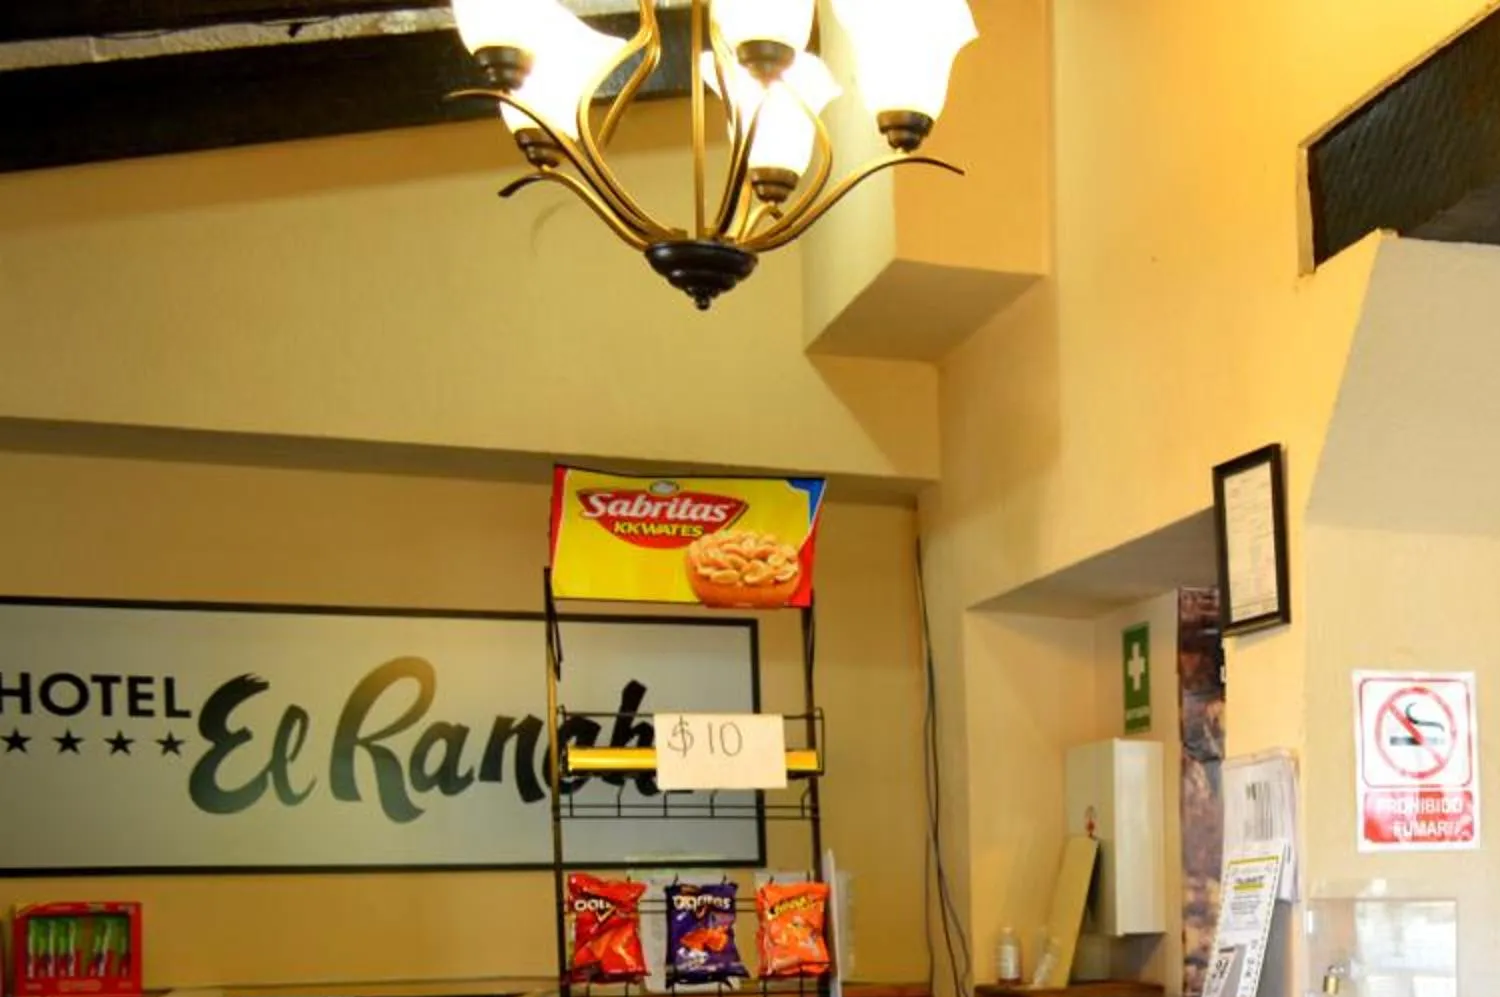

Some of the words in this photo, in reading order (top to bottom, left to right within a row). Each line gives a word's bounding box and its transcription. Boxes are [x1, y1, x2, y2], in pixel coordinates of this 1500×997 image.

[583, 492, 729, 523] Sabritas
[0, 672, 192, 718] HOTEL
[188, 672, 318, 816] El
[328, 655, 662, 825] Ranch
